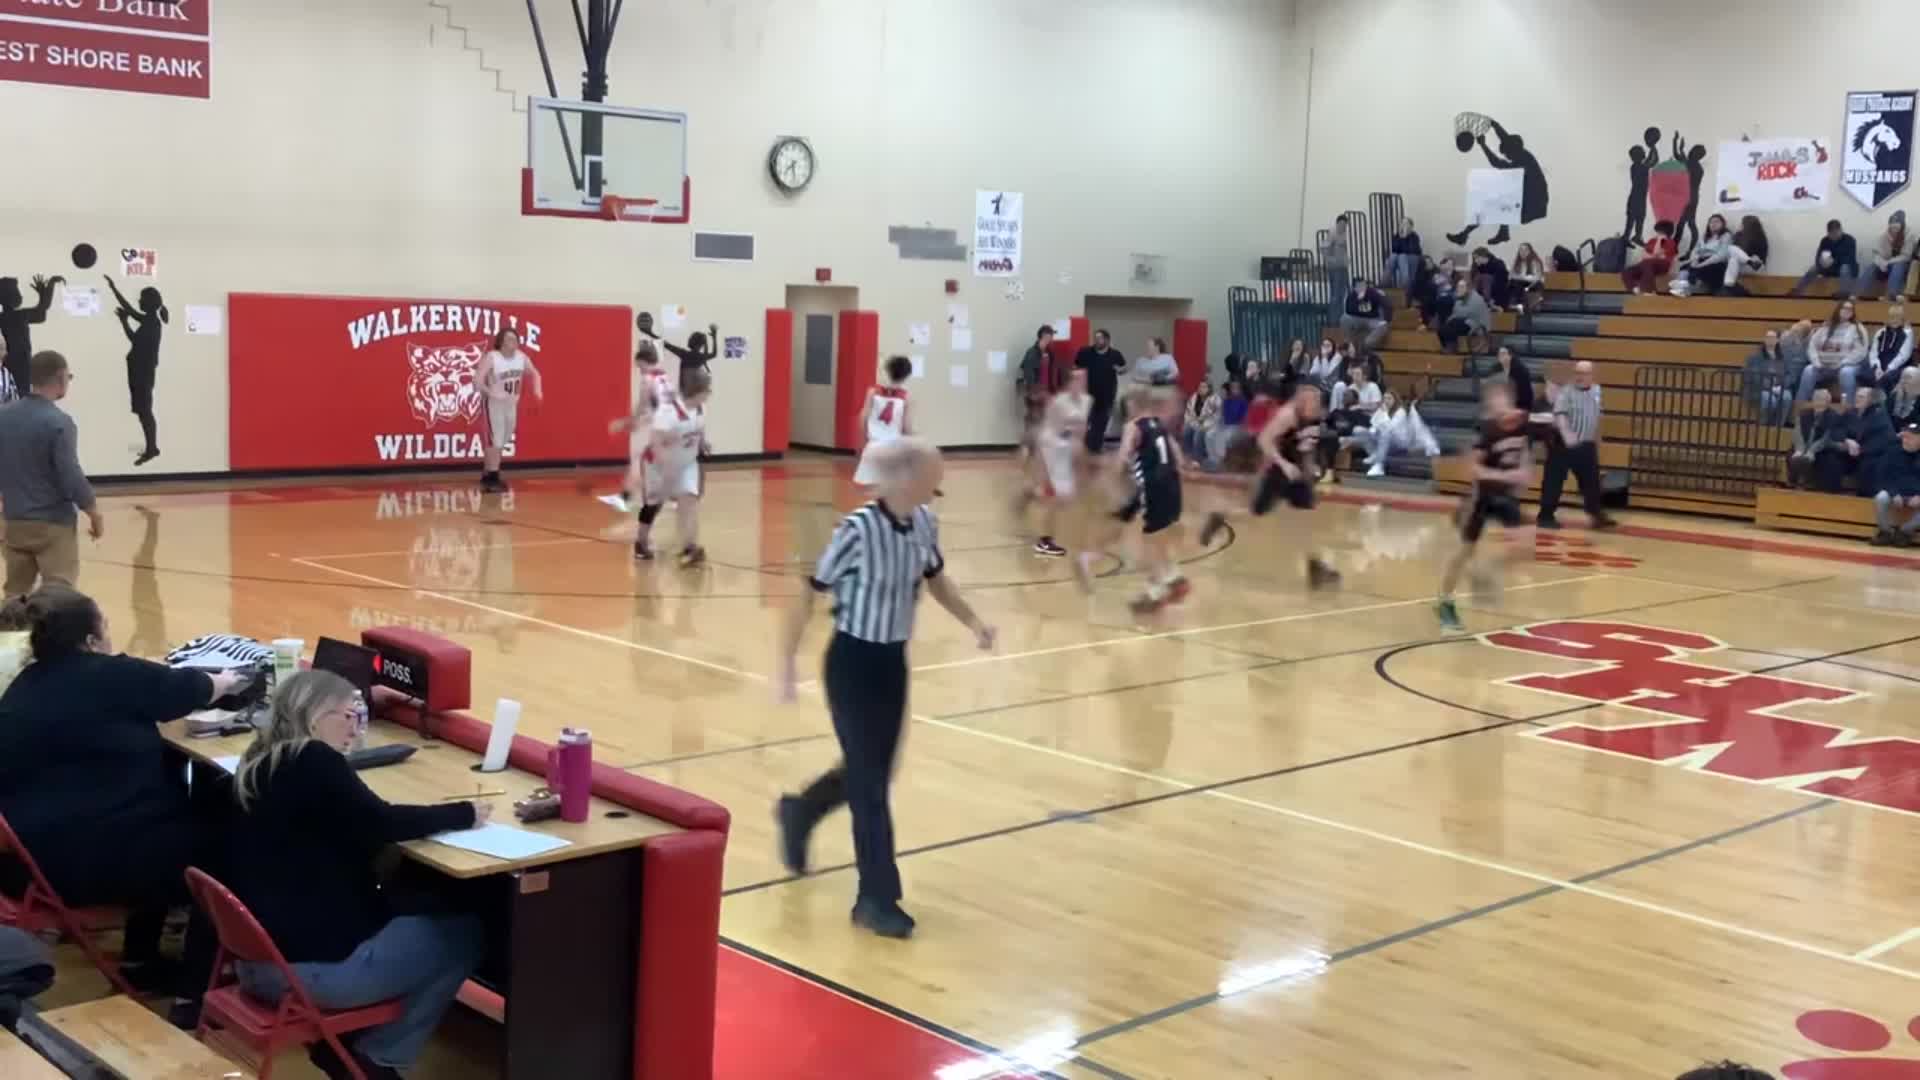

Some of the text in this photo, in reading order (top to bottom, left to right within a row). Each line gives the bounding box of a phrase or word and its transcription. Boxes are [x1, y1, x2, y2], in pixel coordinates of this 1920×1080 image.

[47, 45, 130, 72] SHORE
[138, 54, 203, 79] BANK
[1757, 161, 1799, 181] ROCK
[1846, 169, 1906, 184] MUSTANGS
[878, 401, 894, 424] 4
[375, 433, 516, 459] WILDCAS
[1155, 435, 1168, 464] 1
